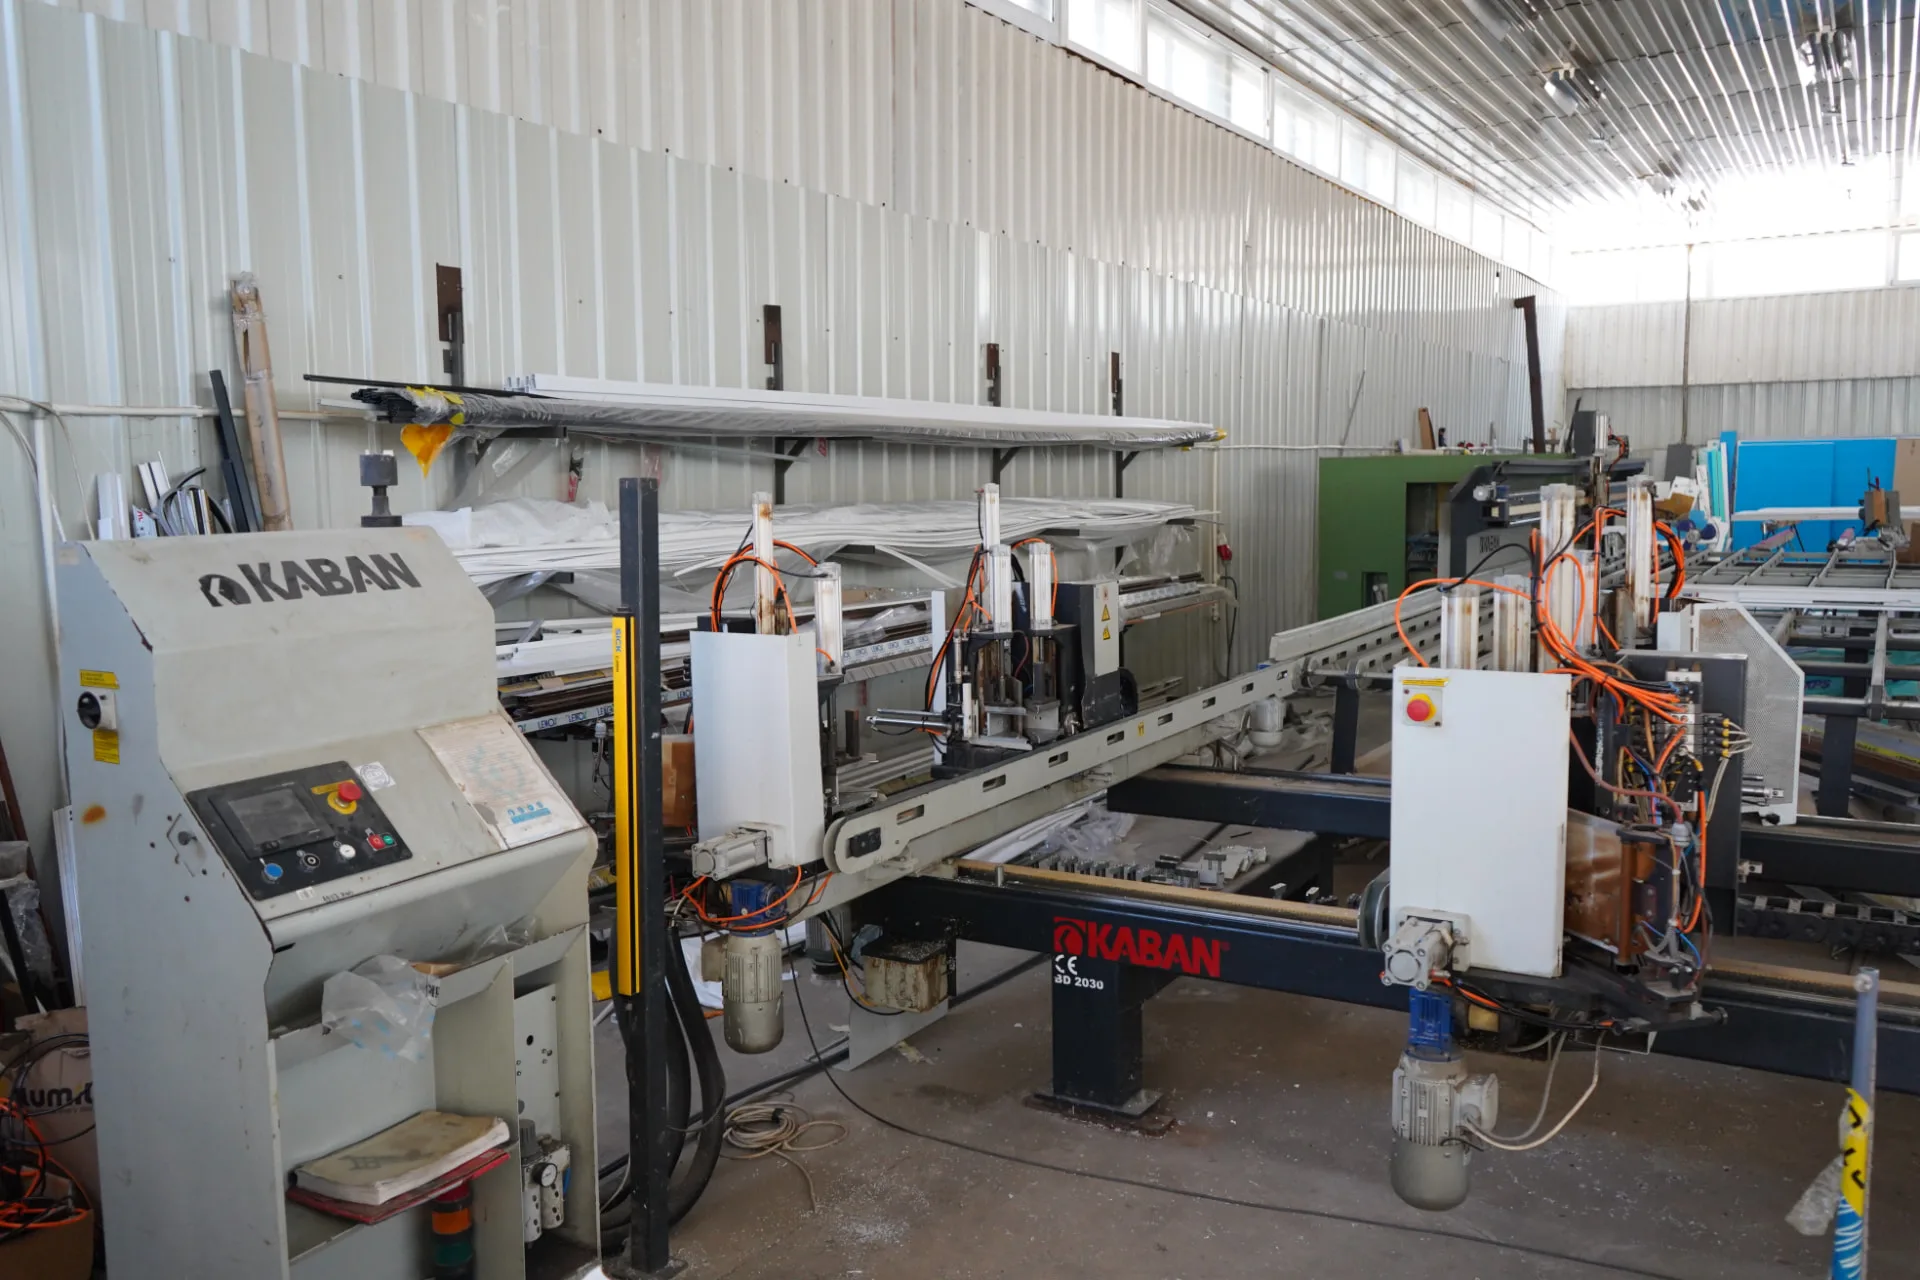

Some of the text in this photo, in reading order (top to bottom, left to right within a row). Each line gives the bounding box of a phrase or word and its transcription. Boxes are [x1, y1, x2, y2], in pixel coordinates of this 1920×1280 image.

[237, 552, 421, 602] KABAN
[1087, 921, 1220, 978] KABAN
[1074, 976, 1104, 990] 2030
